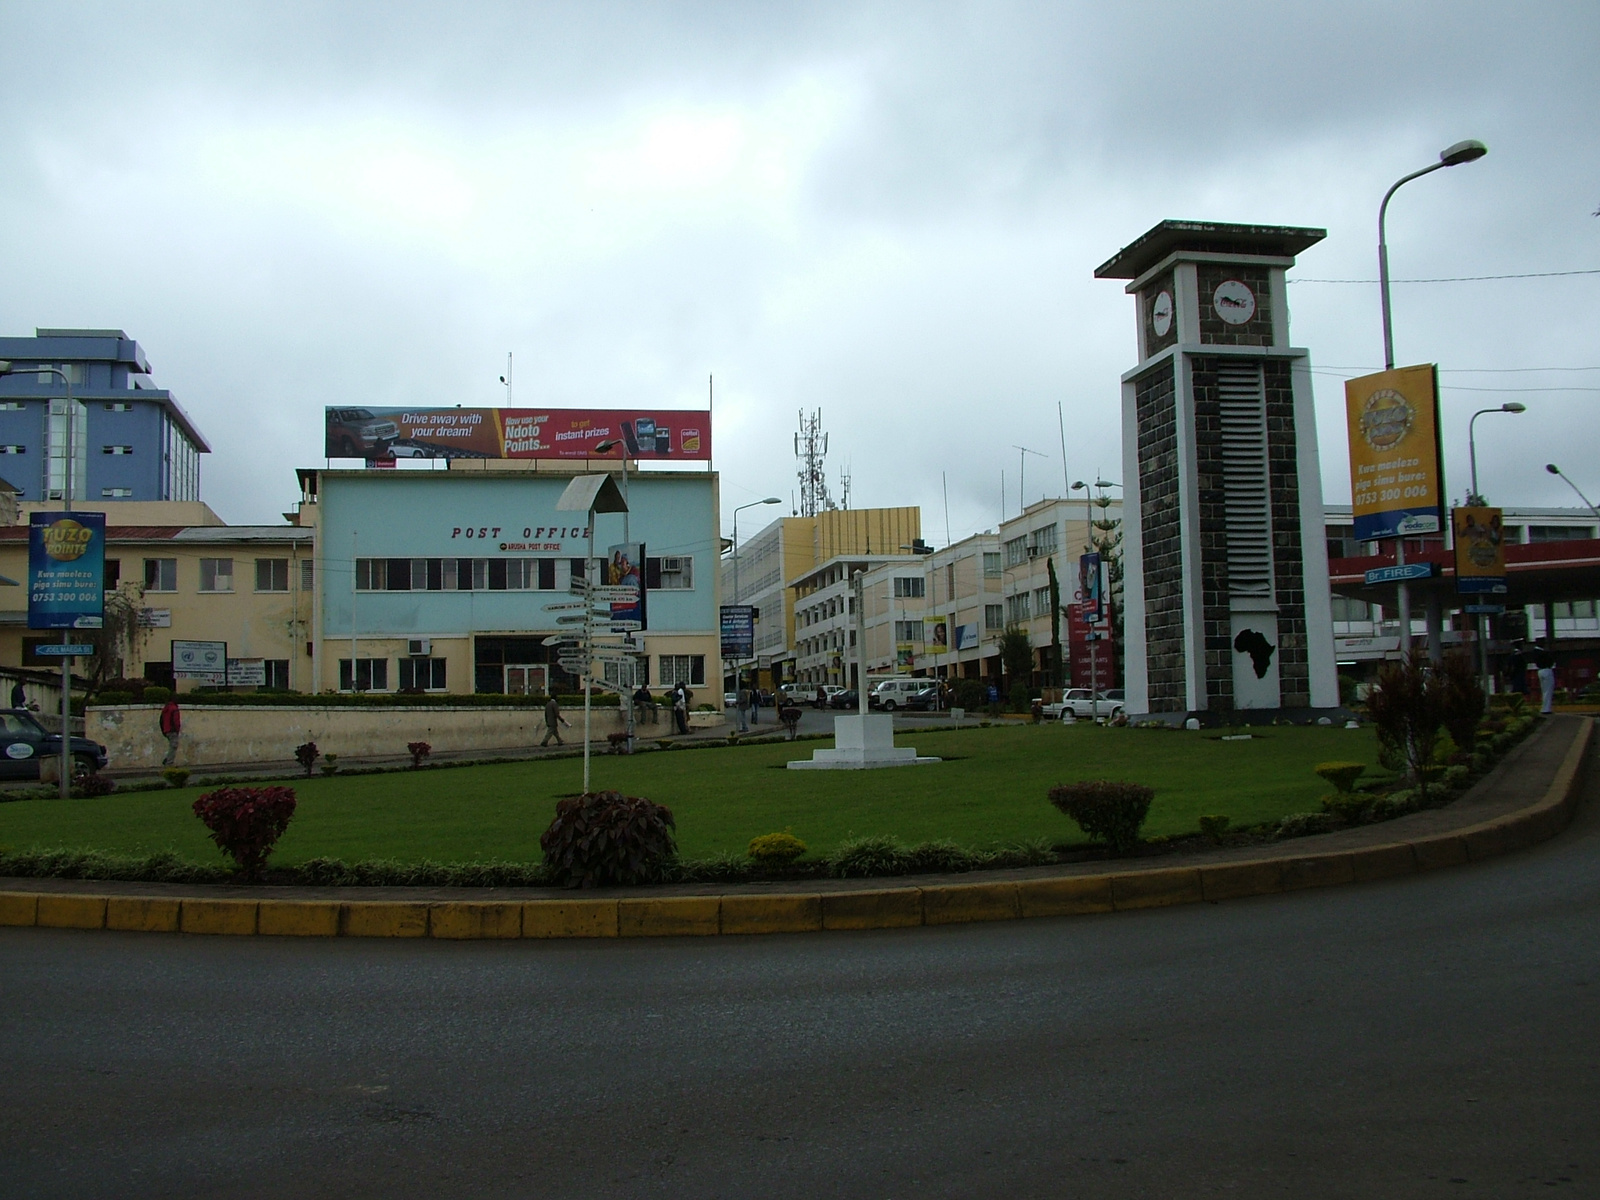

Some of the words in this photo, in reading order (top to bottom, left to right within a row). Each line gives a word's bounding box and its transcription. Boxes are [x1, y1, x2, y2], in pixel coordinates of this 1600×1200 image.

[402, 413, 428, 424] Drive
[430, 416, 458, 426] away
[460, 414, 482, 424] with
[533, 416, 549, 425] your
[571, 420, 578, 428] to
[579, 420, 590, 429] get
[411, 428, 435, 438] your
[436, 426, 473, 437] dream!
[505, 425, 539, 438] Ndoto
[556, 430, 583, 441] instant
[585, 428, 609, 439] prizes
[504, 439, 550, 453] Points...
[1358, 464, 1375, 475] Kwa
[1378, 458, 1418, 471] maelezo
[1355, 480, 1371, 492] piga
[1374, 475, 1395, 486] simu
[1398, 472, 1426, 482] bure:
[1356, 492, 1377, 506] 0753
[1380, 488, 1400, 500] 300
[1404, 485, 1427, 498] 006
[43, 528, 92, 542] TUZO
[452, 528, 501, 538] POST
[523, 528, 589, 538] OFFICE
[46, 544, 87, 554] POINTS
[38, 570, 54, 578] Kwa
[57, 570, 92, 578] maelezo
[1368, 572, 1382, 580] Br.
[1384, 567, 1413, 578] FIRE
[34, 581, 50, 590] piga
[75, 580, 96, 588] bure:
[32, 594, 55, 602] 0753
[58, 593, 76, 601] 300
